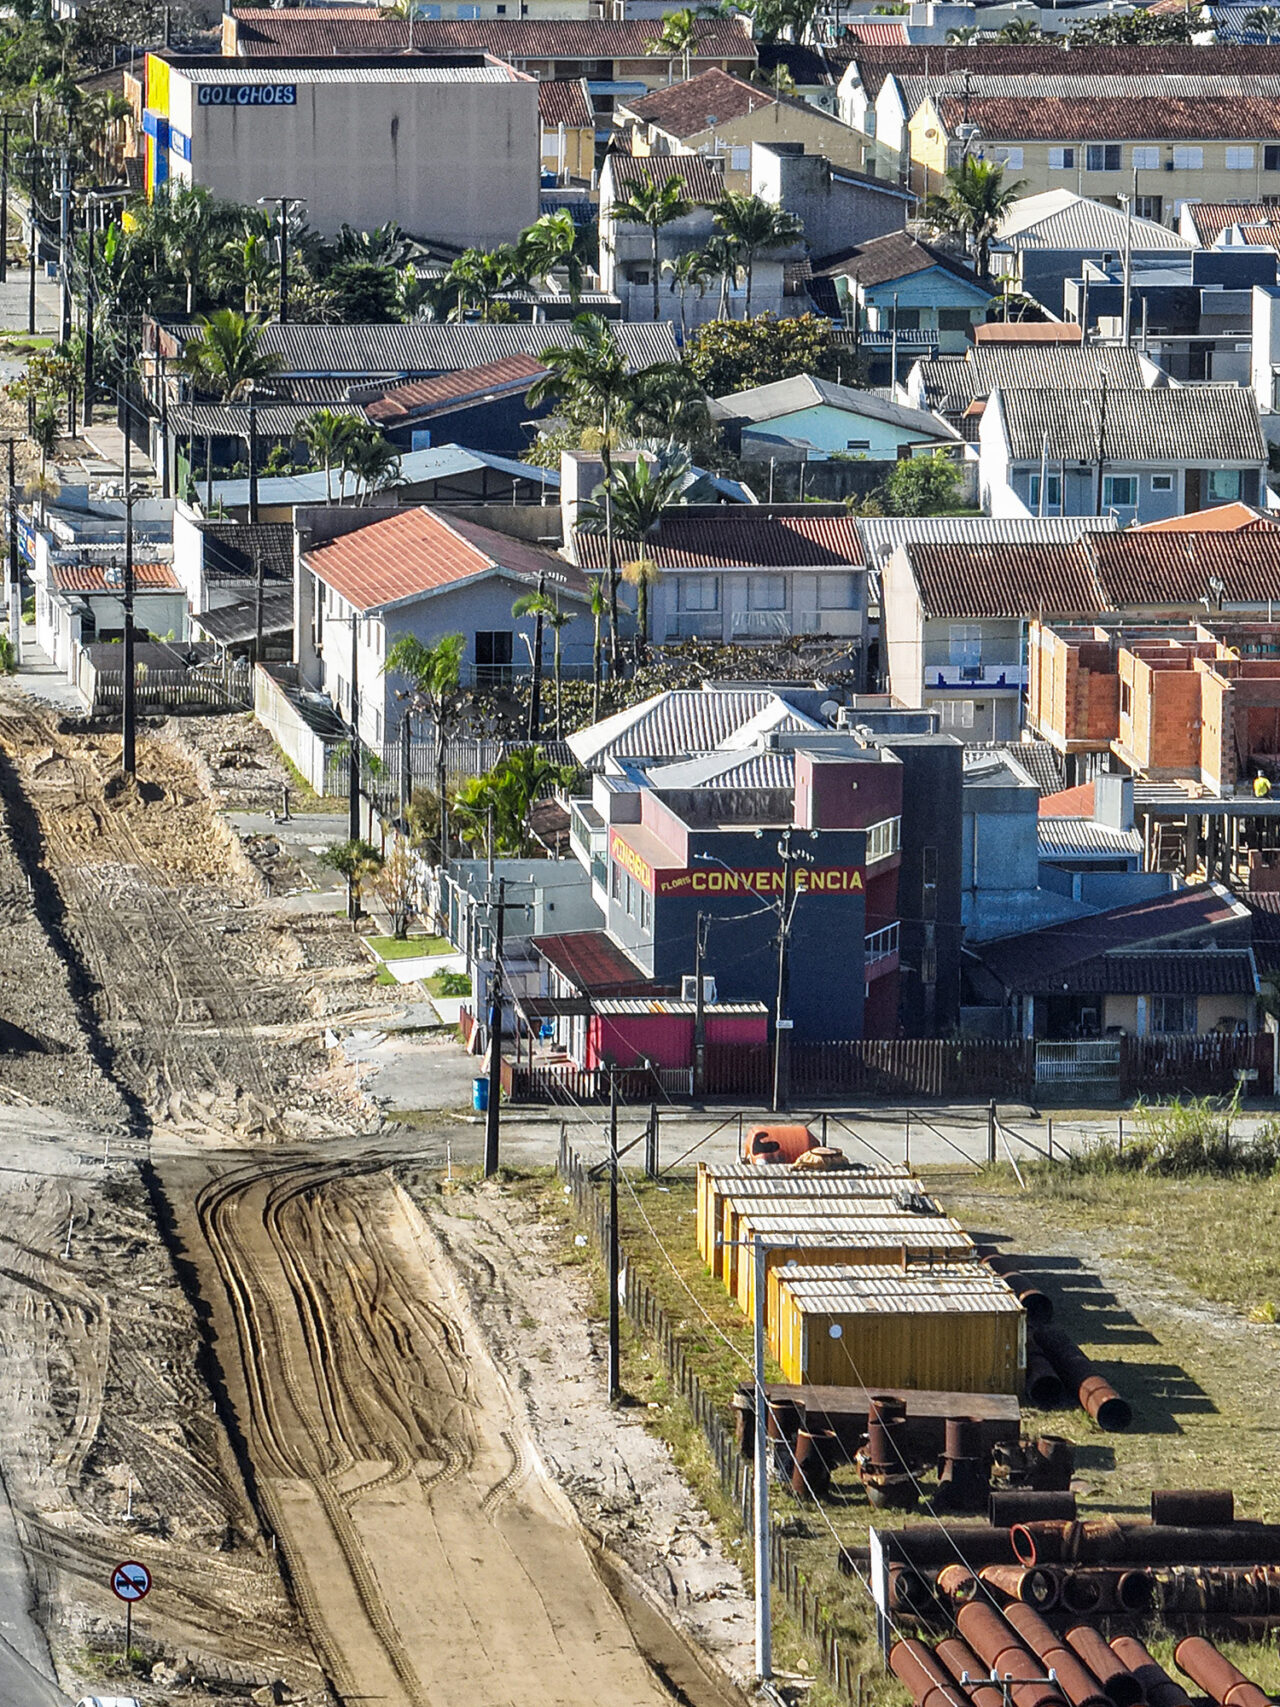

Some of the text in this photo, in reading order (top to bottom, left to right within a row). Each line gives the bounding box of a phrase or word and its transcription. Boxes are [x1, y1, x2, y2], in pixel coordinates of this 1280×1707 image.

[199, 84, 295, 105] COLCHÕES
[661, 868, 863, 891] FLORIS CONVENÊNCIA
